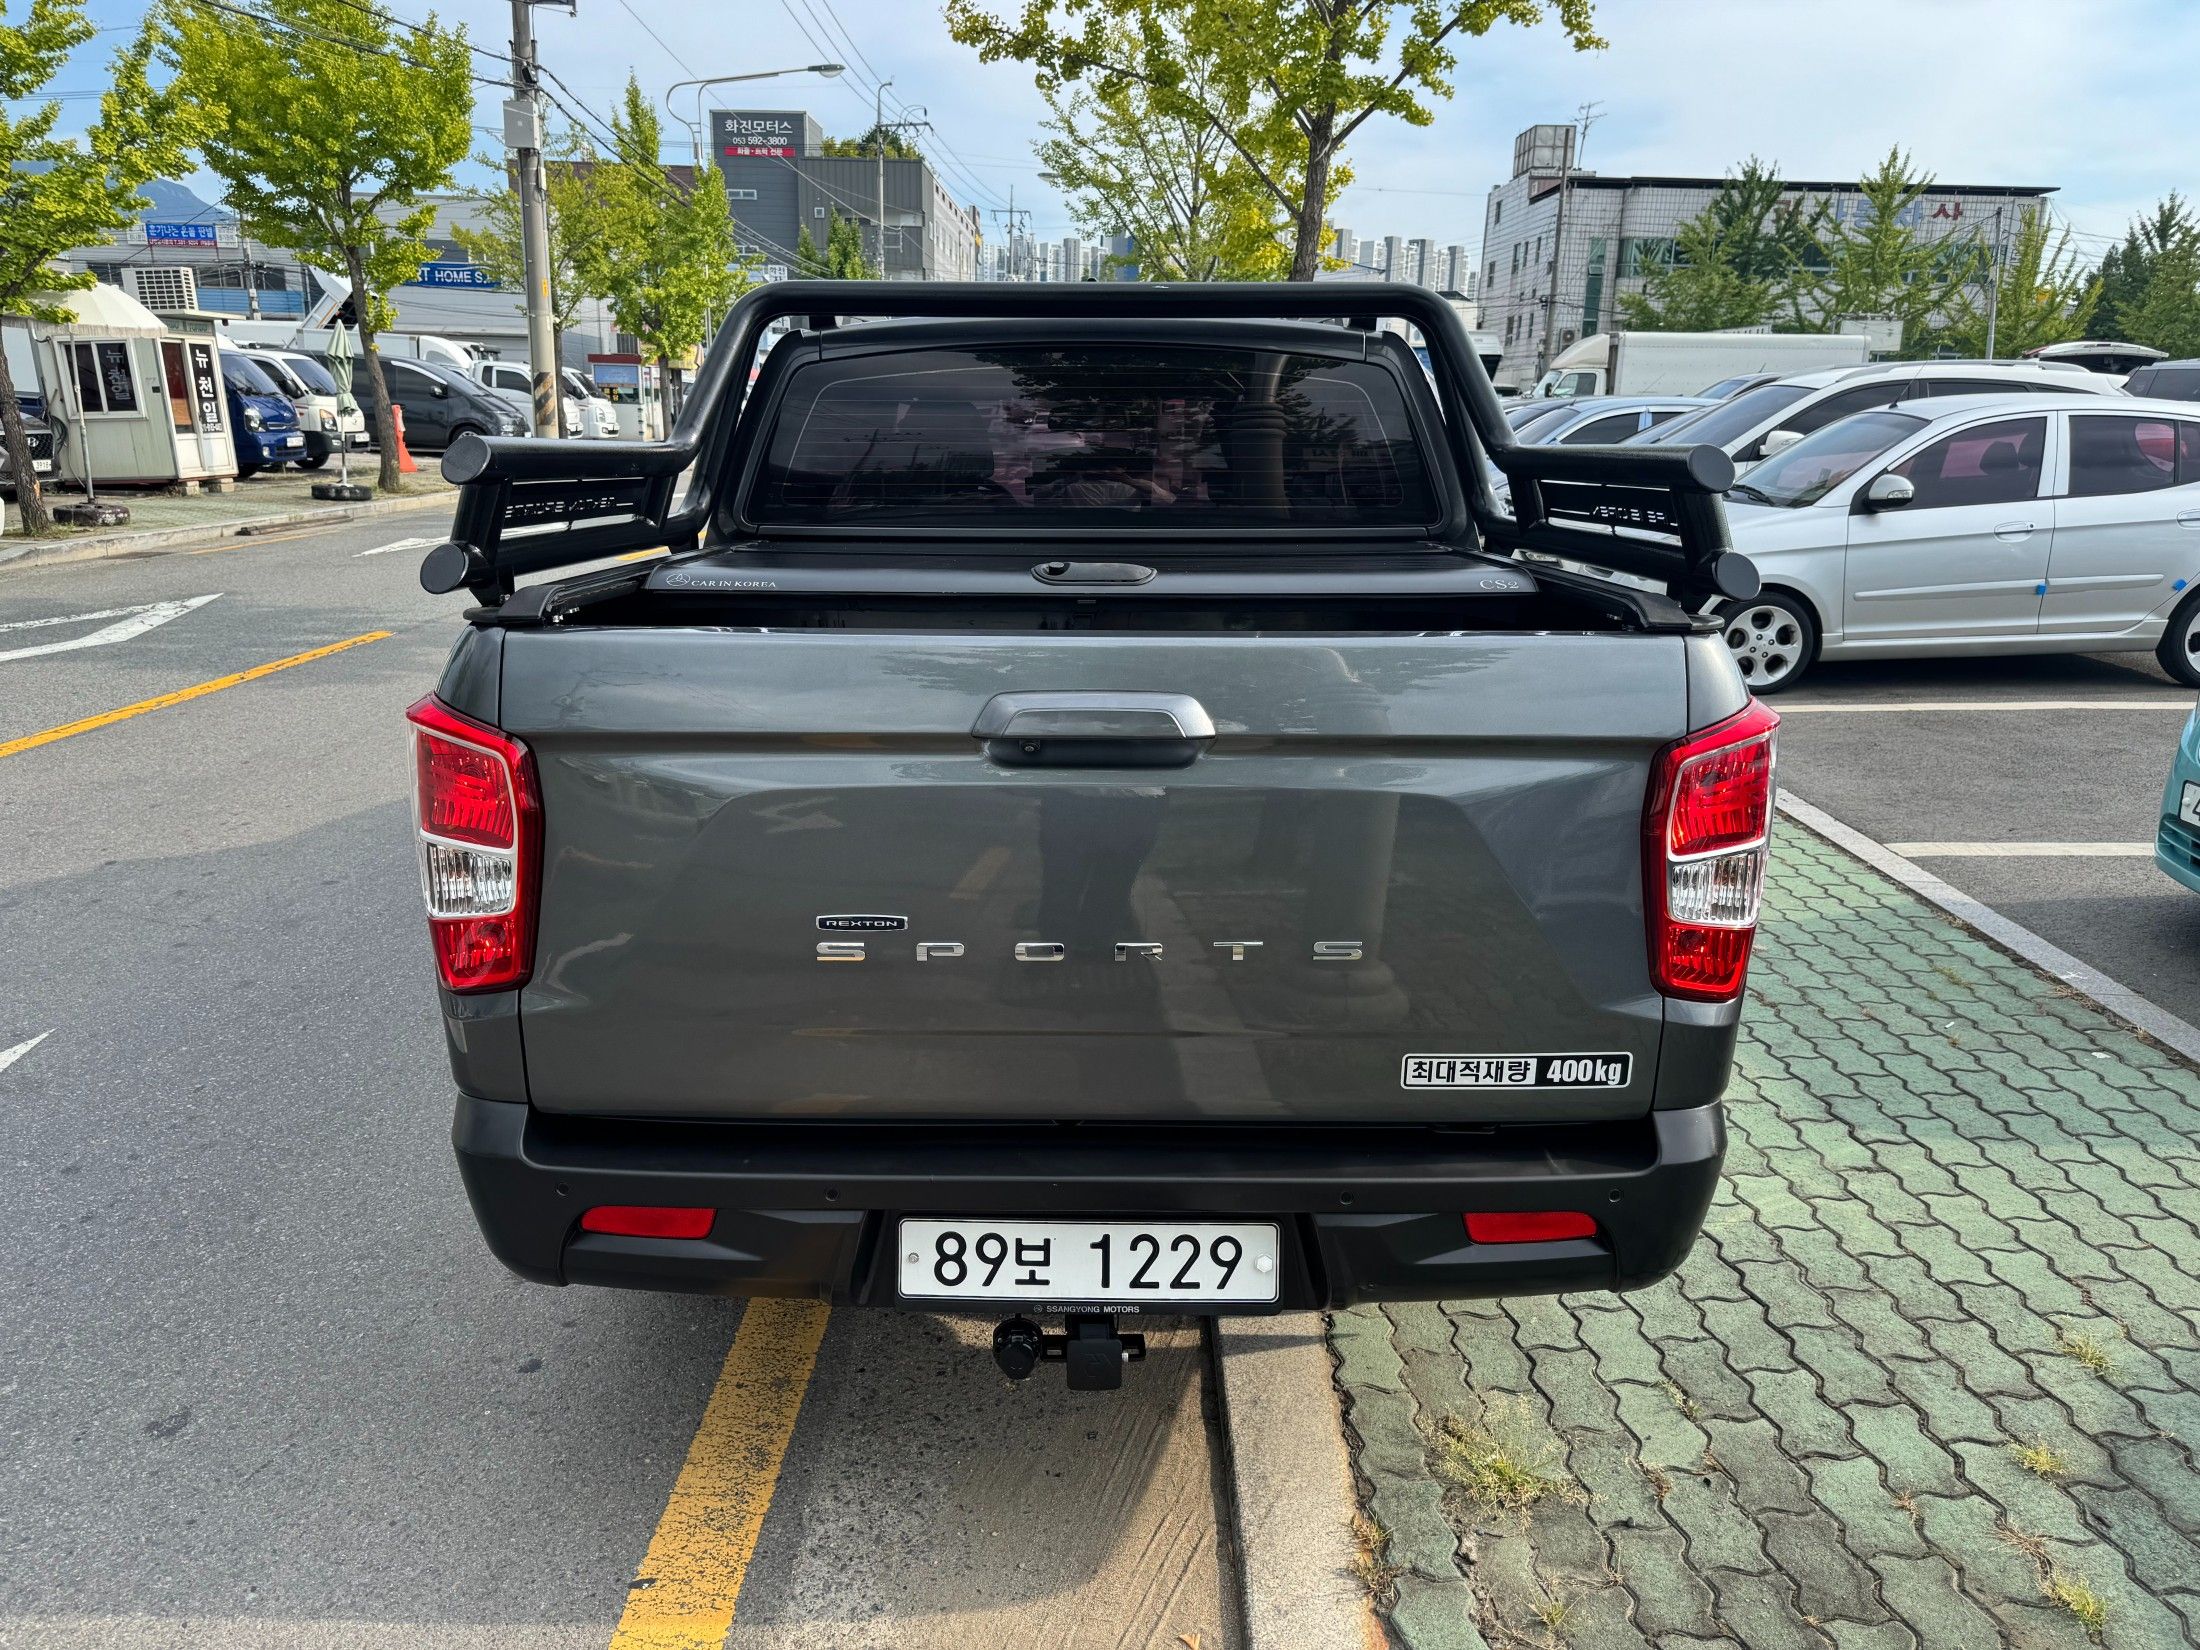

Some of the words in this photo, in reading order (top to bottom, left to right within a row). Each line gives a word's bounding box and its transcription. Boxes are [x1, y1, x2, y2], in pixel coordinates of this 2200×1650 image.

[724, 119, 793, 134] 화진모터스
[732, 136, 746, 145] 053
[747, 136, 788, 146] 592-3800
[434, 270, 472, 283] HOME
[1480, 580, 1519, 589] CS2
[826, 920, 898, 928] REXTON
[816, 941, 1363, 962] SPORTS
[1411, 1060, 1531, 1083] 최대적재량
[1546, 1059, 1622, 1085] 400kg
[933, 1230, 1051, 1287] 89보
[1089, 1233, 1243, 1290] 1229
[1046, 1305, 1100, 1313] SSANGYONG
[1103, 1305, 1140, 1313] MOTORS
